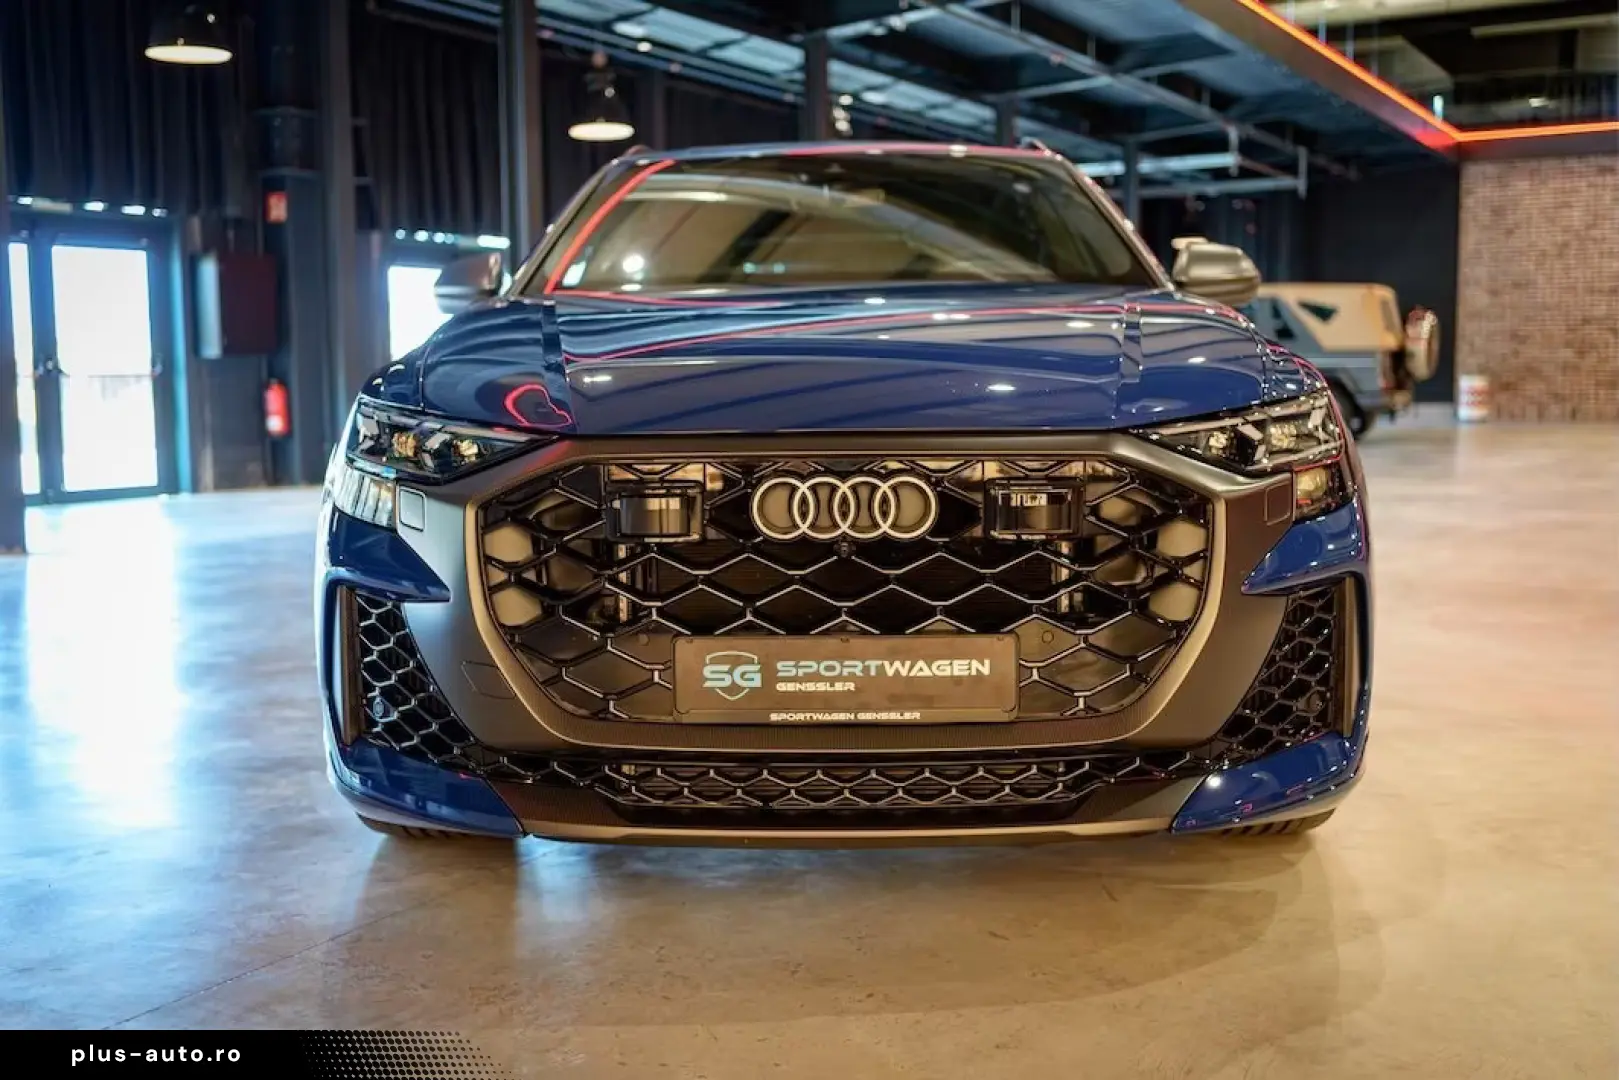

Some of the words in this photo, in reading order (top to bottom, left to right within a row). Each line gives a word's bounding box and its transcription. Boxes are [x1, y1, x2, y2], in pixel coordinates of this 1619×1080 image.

[776, 659, 991, 677] SPORTWAGEN
[702, 665, 762, 688] SG
[776, 681, 856, 691] GENSSLER
[769, 712, 855, 721] SPORTWAGEN
[857, 711, 921, 720] GENSSLER
